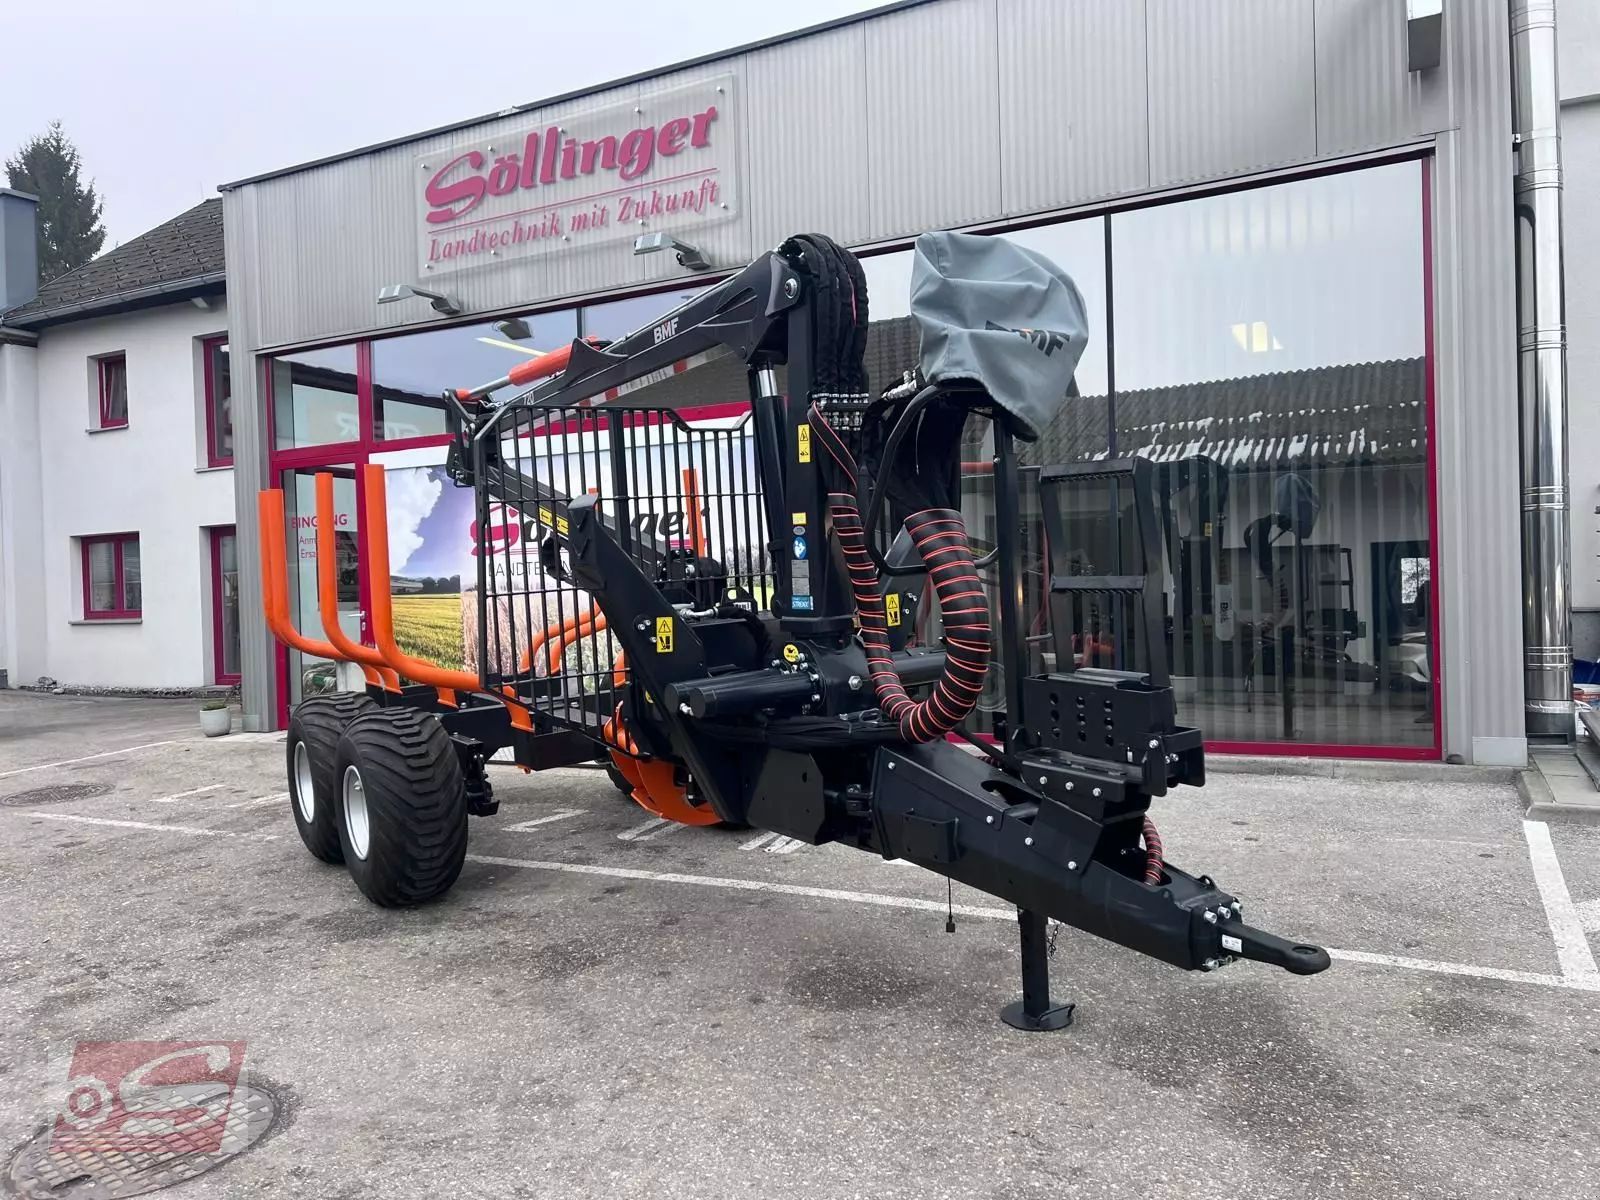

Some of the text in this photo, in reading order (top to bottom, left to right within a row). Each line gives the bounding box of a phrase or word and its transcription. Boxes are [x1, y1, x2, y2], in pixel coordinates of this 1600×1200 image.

[425, 106, 719, 224] Söllinger
[428, 178, 720, 262] Landtechnik mit Zukunft
[653, 317, 679, 344] BMF
